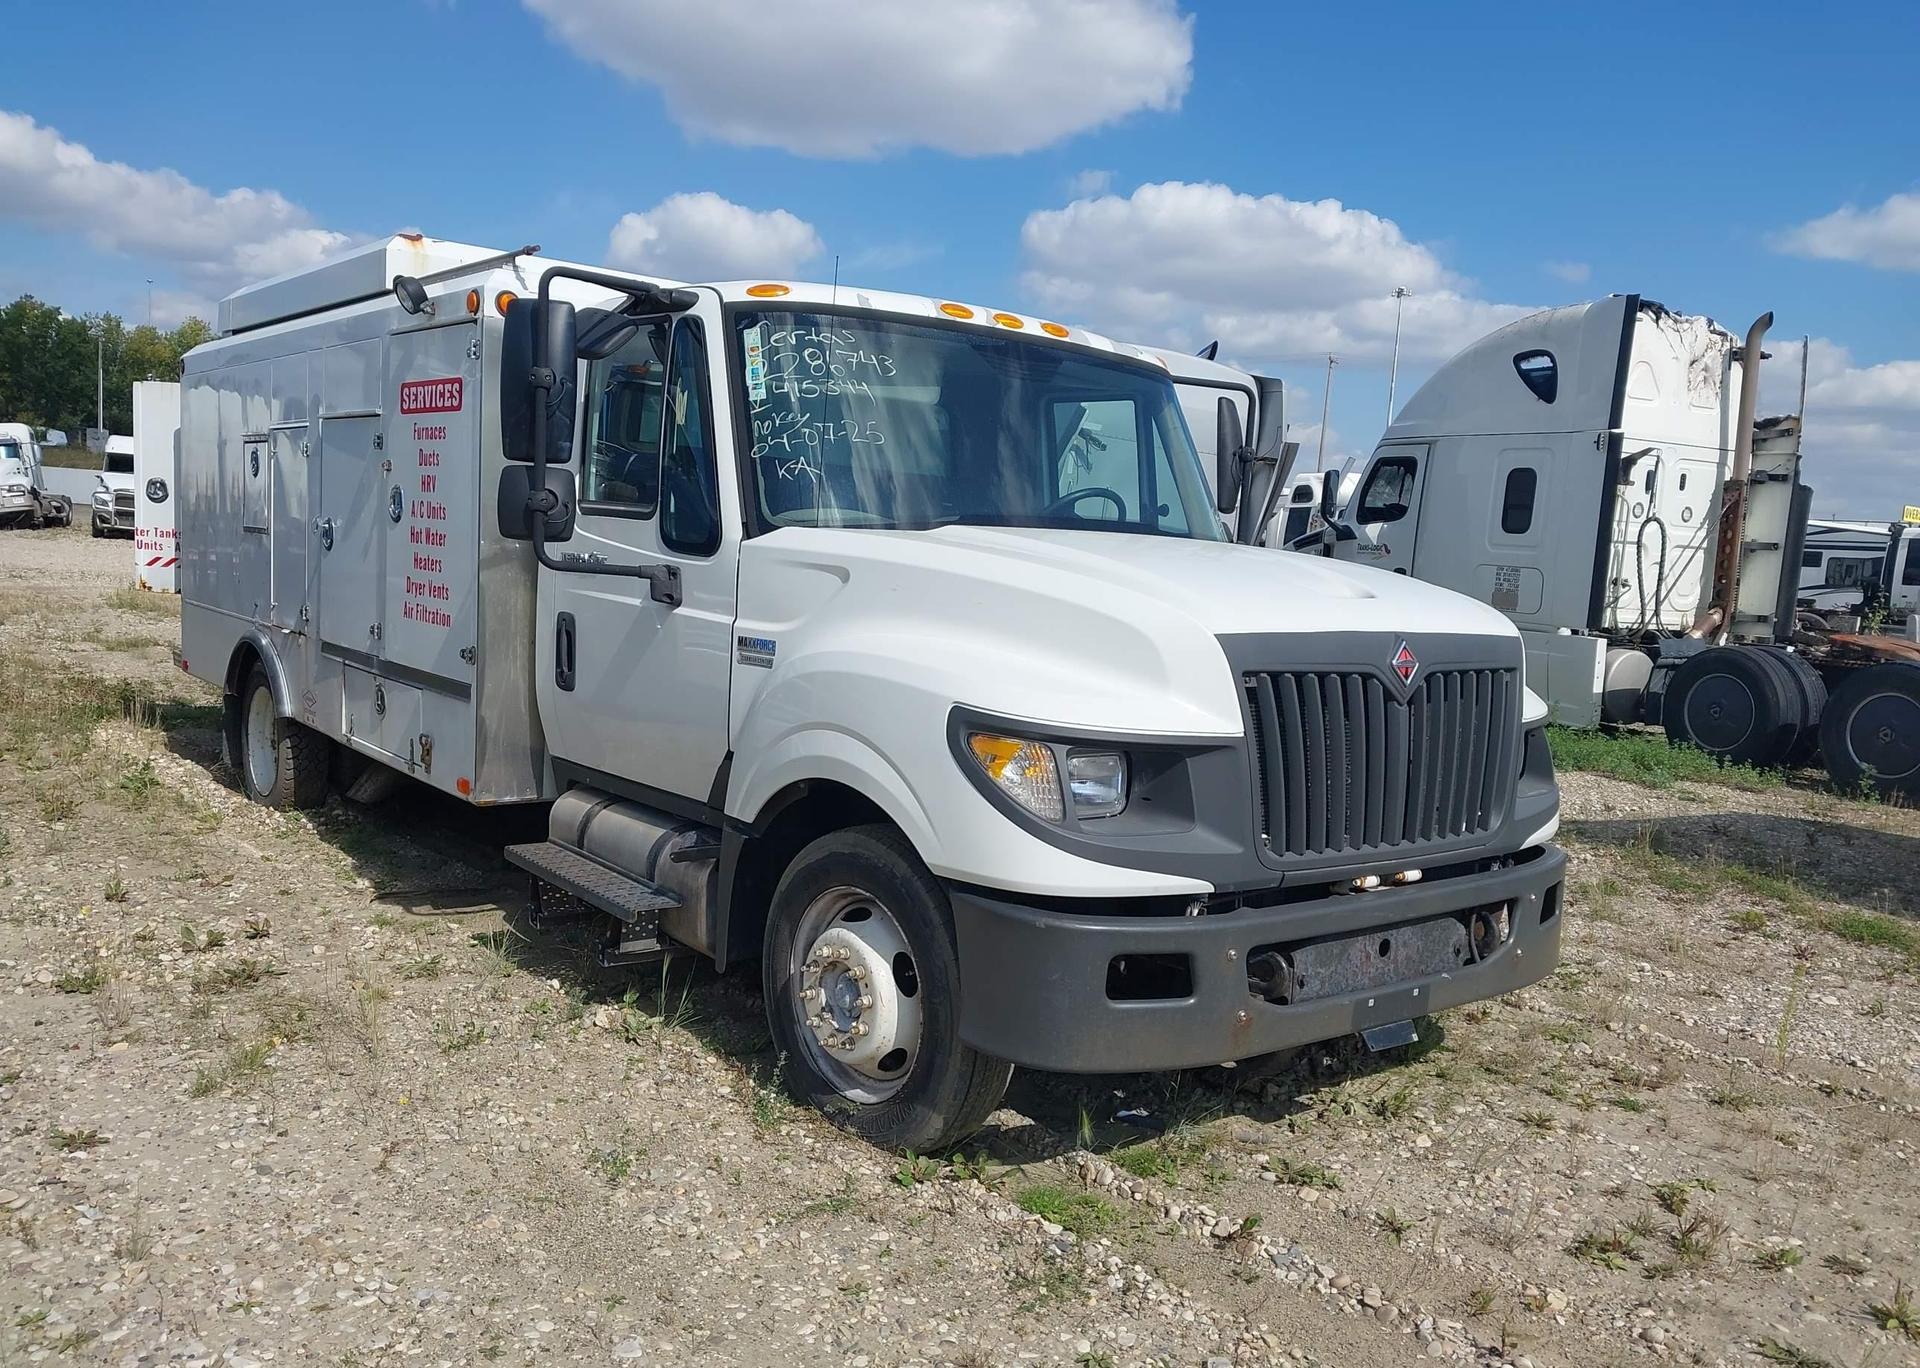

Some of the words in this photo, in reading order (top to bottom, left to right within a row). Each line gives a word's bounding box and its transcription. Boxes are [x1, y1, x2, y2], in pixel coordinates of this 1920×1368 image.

[402, 382, 460, 410] SERVICES
[413, 422, 447, 440] Furnaces
[418, 448, 440, 467] Ducts
[421, 474, 437, 493] HRV
[411, 499, 425, 519] A/C
[426, 501, 447, 520] Units
[136, 539, 164, 551] Units
[410, 525, 423, 545] Hot
[425, 527, 447, 547] Water
[413, 551, 442, 573] Heaters
[406, 576, 426, 598] Dryer
[428, 579, 449, 601] Vents
[403, 601, 413, 619] Air
[415, 603, 451, 627] Filtration
